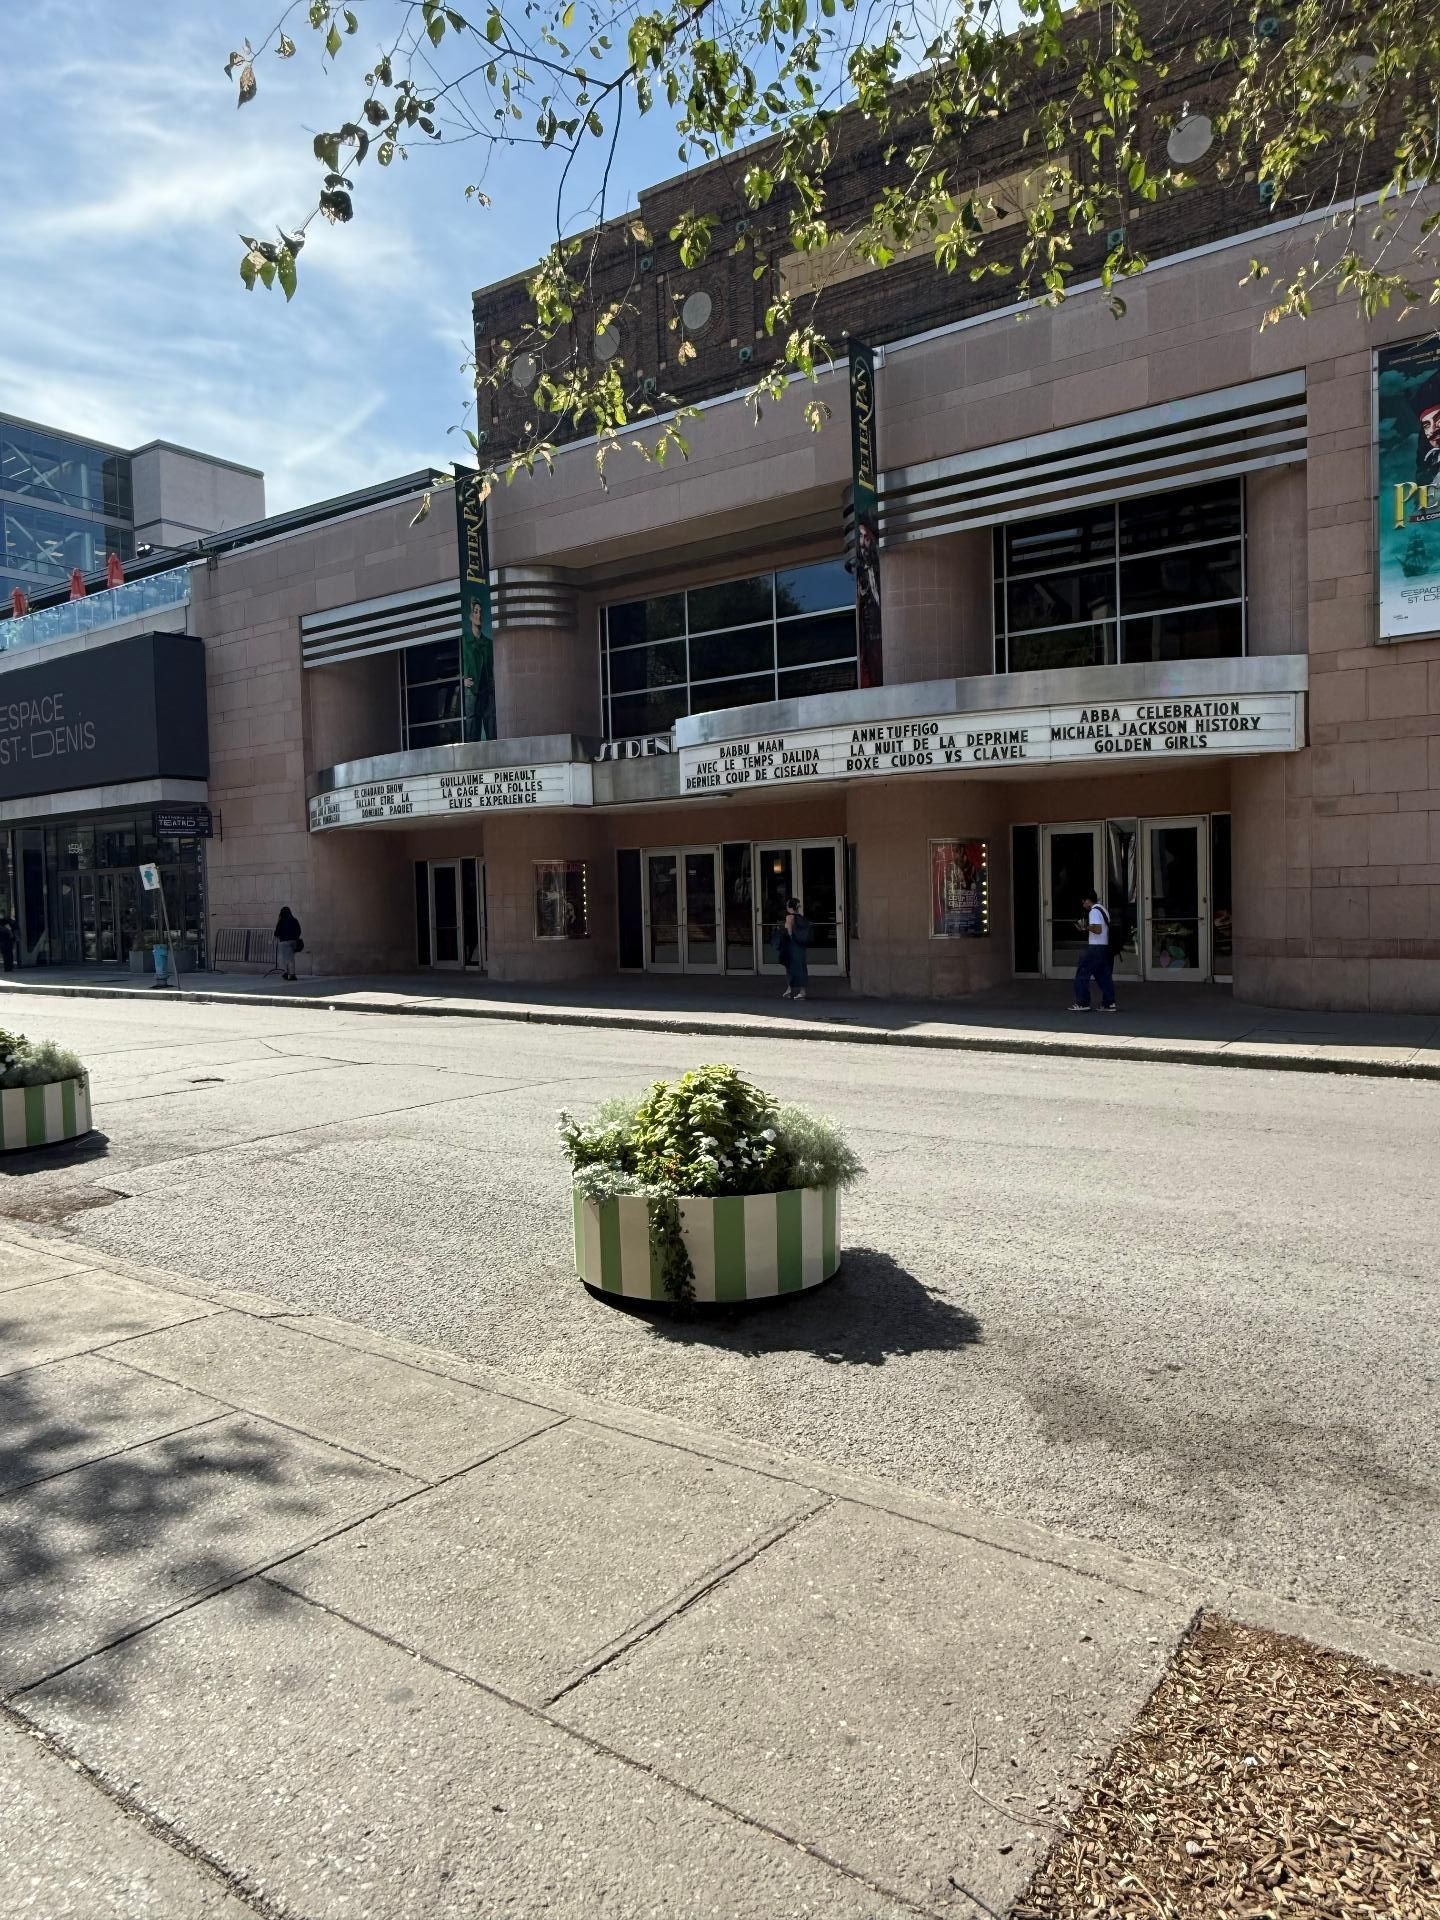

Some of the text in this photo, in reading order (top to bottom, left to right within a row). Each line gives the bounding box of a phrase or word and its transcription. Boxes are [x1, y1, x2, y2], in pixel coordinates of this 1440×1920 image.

[855, 364, 875, 492] PETER PAN
[466, 524, 486, 585] PETER
[1079, 701, 1240, 723] ABBA CELEBRATION
[1051, 716, 1261, 741] MICHAEL JACKSON HISTORY
[719, 739, 784, 758] BABBU MAAN
[850, 729, 1029, 757] LA NUIT DE LA DEPRIME
[1094, 737, 1152, 753] GOLDEN
[696, 748, 820, 775] AVEC LE TEMPS DALIDA
[846, 745, 1027, 771] BOXE CUDOS VS CLAVEL
[440, 769, 536, 788] GUILLAUME PINEAULT
[686, 762, 819, 790] DERNIER COUP DE CISEAUX
[386, 783, 404, 793] SHOW
[401, 792, 410, 803] LA
[442, 780, 543, 799] LA CAGE AUX FOLLES
[389, 803, 414, 815] PAQUET
[449, 792, 537, 809] ELVIS EXPERIENCE
